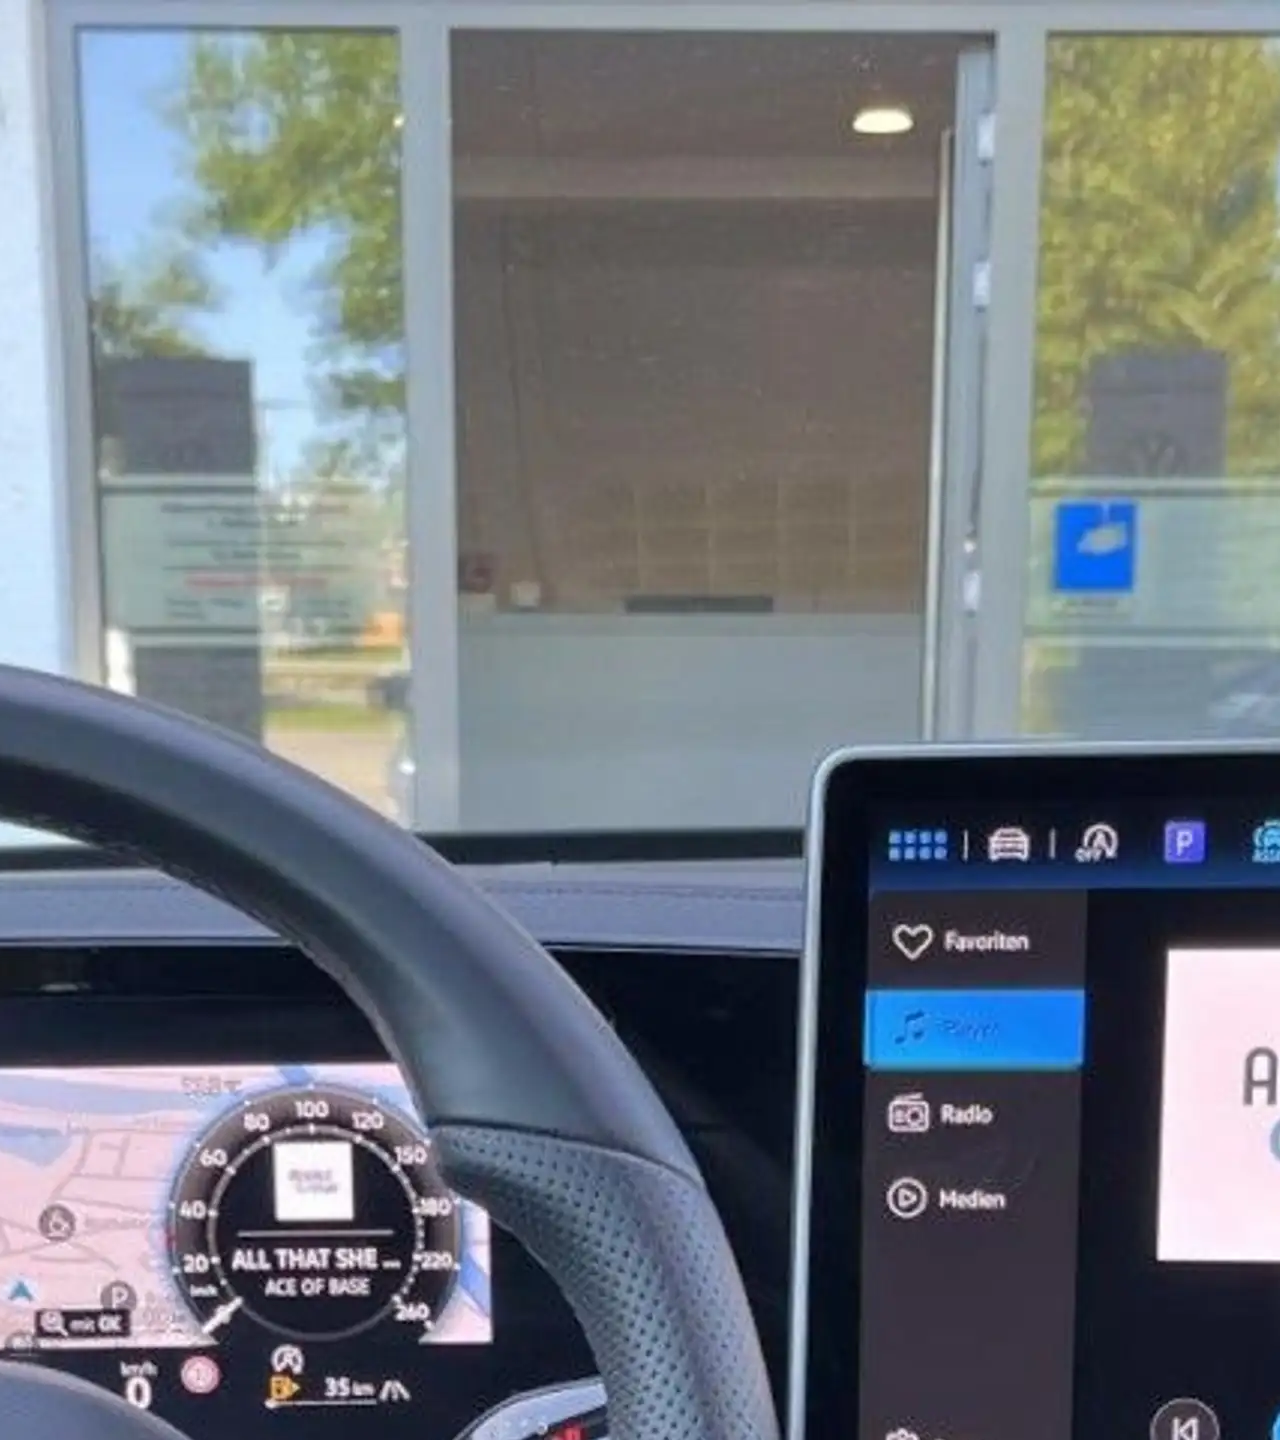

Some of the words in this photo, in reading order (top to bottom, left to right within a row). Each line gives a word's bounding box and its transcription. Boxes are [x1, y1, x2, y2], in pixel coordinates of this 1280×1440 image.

[943, 930, 1030, 952] Favoriten
[295, 1101, 329, 1119] 100
[940, 1104, 994, 1125] Radio
[244, 1113, 270, 1132] 80
[352, 1112, 384, 1130] 120
[200, 1147, 228, 1167] 60
[394, 1146, 428, 1165] 150
[939, 1189, 1007, 1210] Medien
[179, 1201, 206, 1220] 40
[183, 1253, 210, 1274] 20
[231, 1248, 271, 1271] ALL
[274, 1248, 331, 1270] THAT
[335, 1247, 379, 1270] SHE
[421, 1251, 454, 1271] 220
[264, 1277, 297, 1297] ACE
[301, 1277, 326, 1297] OF
[328, 1277, 371, 1297] BASE
[394, 1303, 430, 1321] 260
[97, 1314, 122, 1334] OK
[125, 1376, 153, 1410] 0
[323, 1376, 350, 1397] 35
